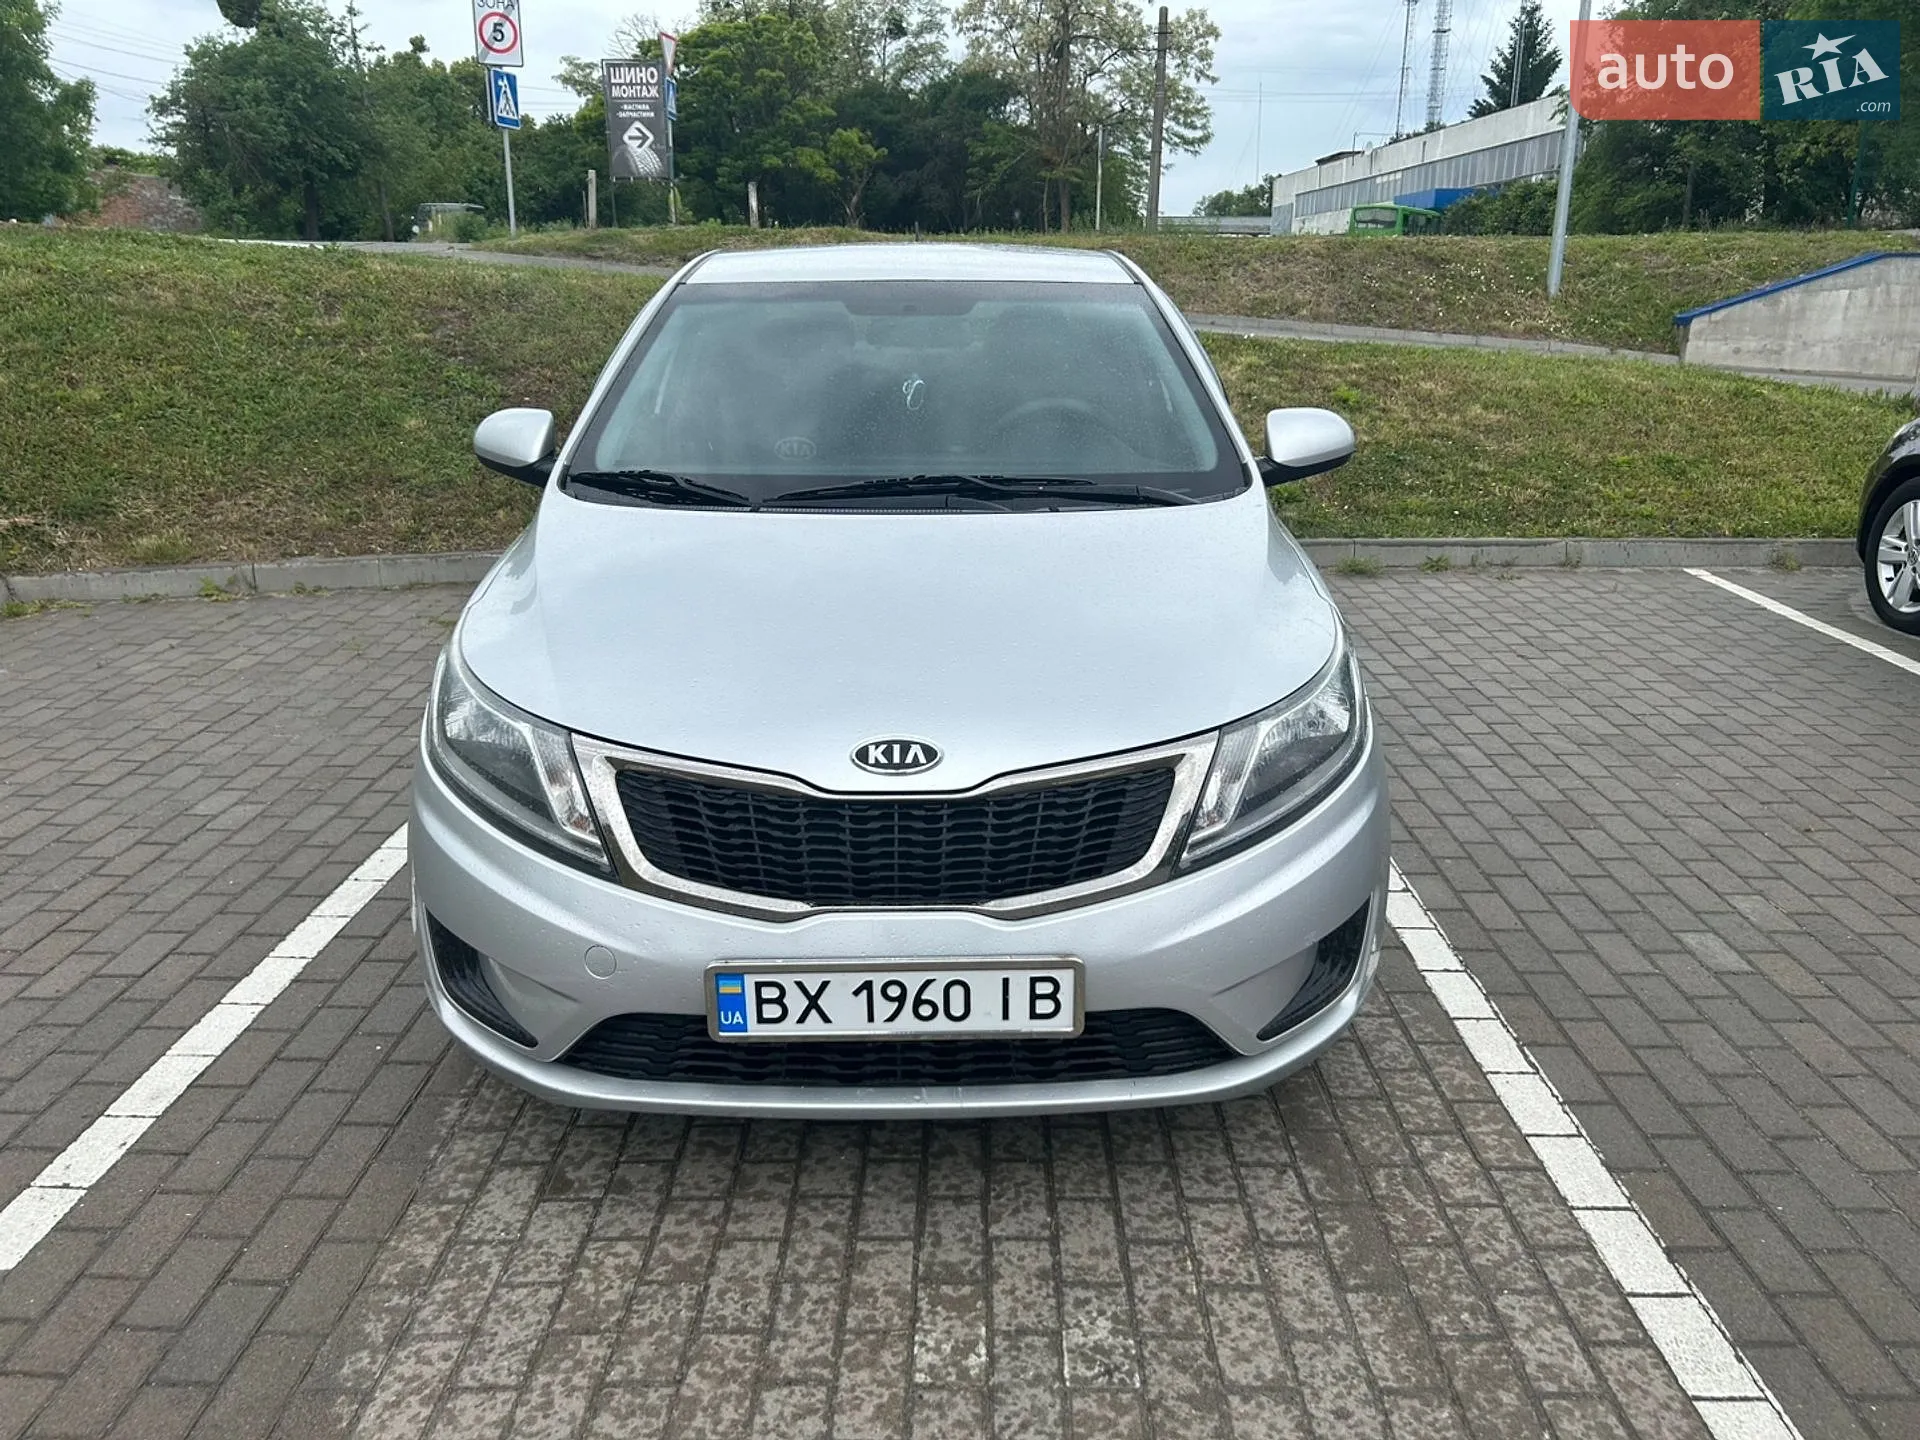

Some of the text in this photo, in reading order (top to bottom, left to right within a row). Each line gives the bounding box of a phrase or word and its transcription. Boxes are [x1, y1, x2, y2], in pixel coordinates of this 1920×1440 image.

[493, 22, 505, 43] 5
[610, 66, 659, 84] ШИНО
[611, 84, 660, 98] МОНТАЖ
[867, 743, 927, 764] KIA
[754, 975, 1062, 1025] BX 1960 IB
[720, 1011, 744, 1025] UA
